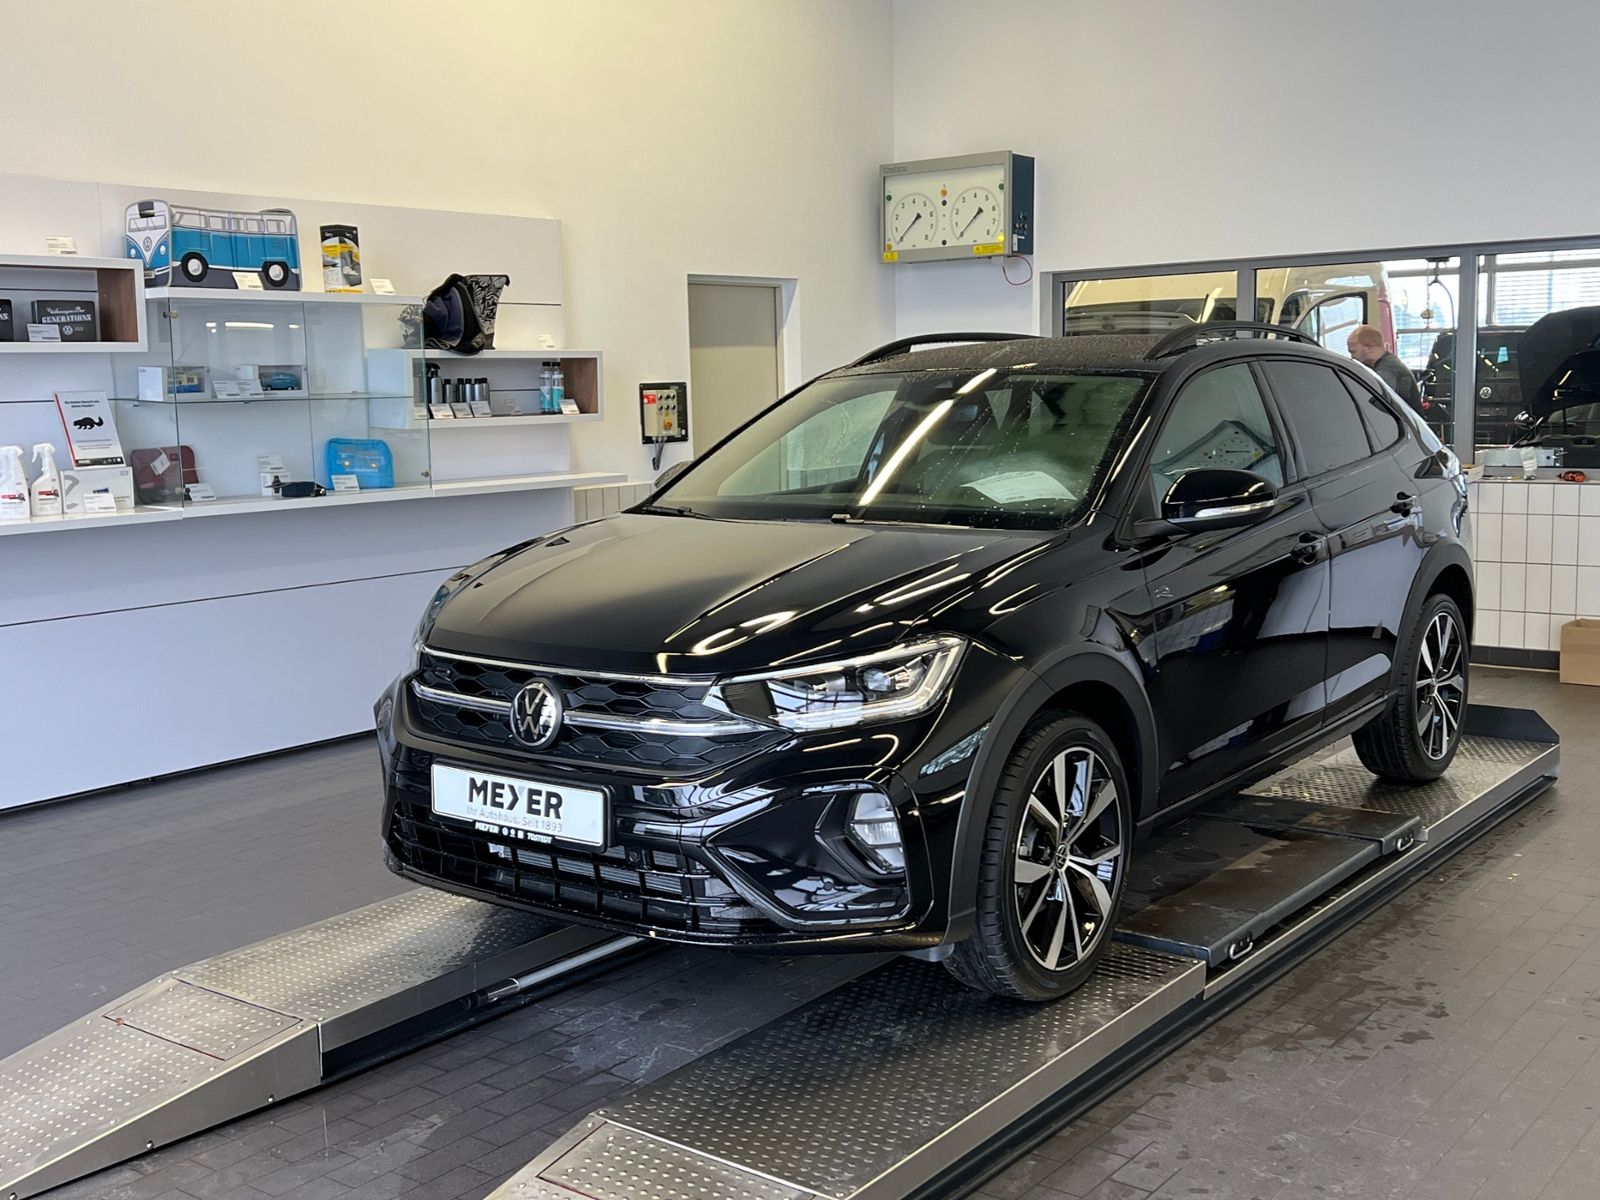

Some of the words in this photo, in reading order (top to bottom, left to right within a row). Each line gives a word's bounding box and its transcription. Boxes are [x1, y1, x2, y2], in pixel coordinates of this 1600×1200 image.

[42, 314, 92, 324] GENERATIONS
[468, 777, 563, 820] MEYER
[466, 806, 477, 816] Ihr
[522, 816, 539, 829] Seit
[542, 820, 563, 832] 1893
